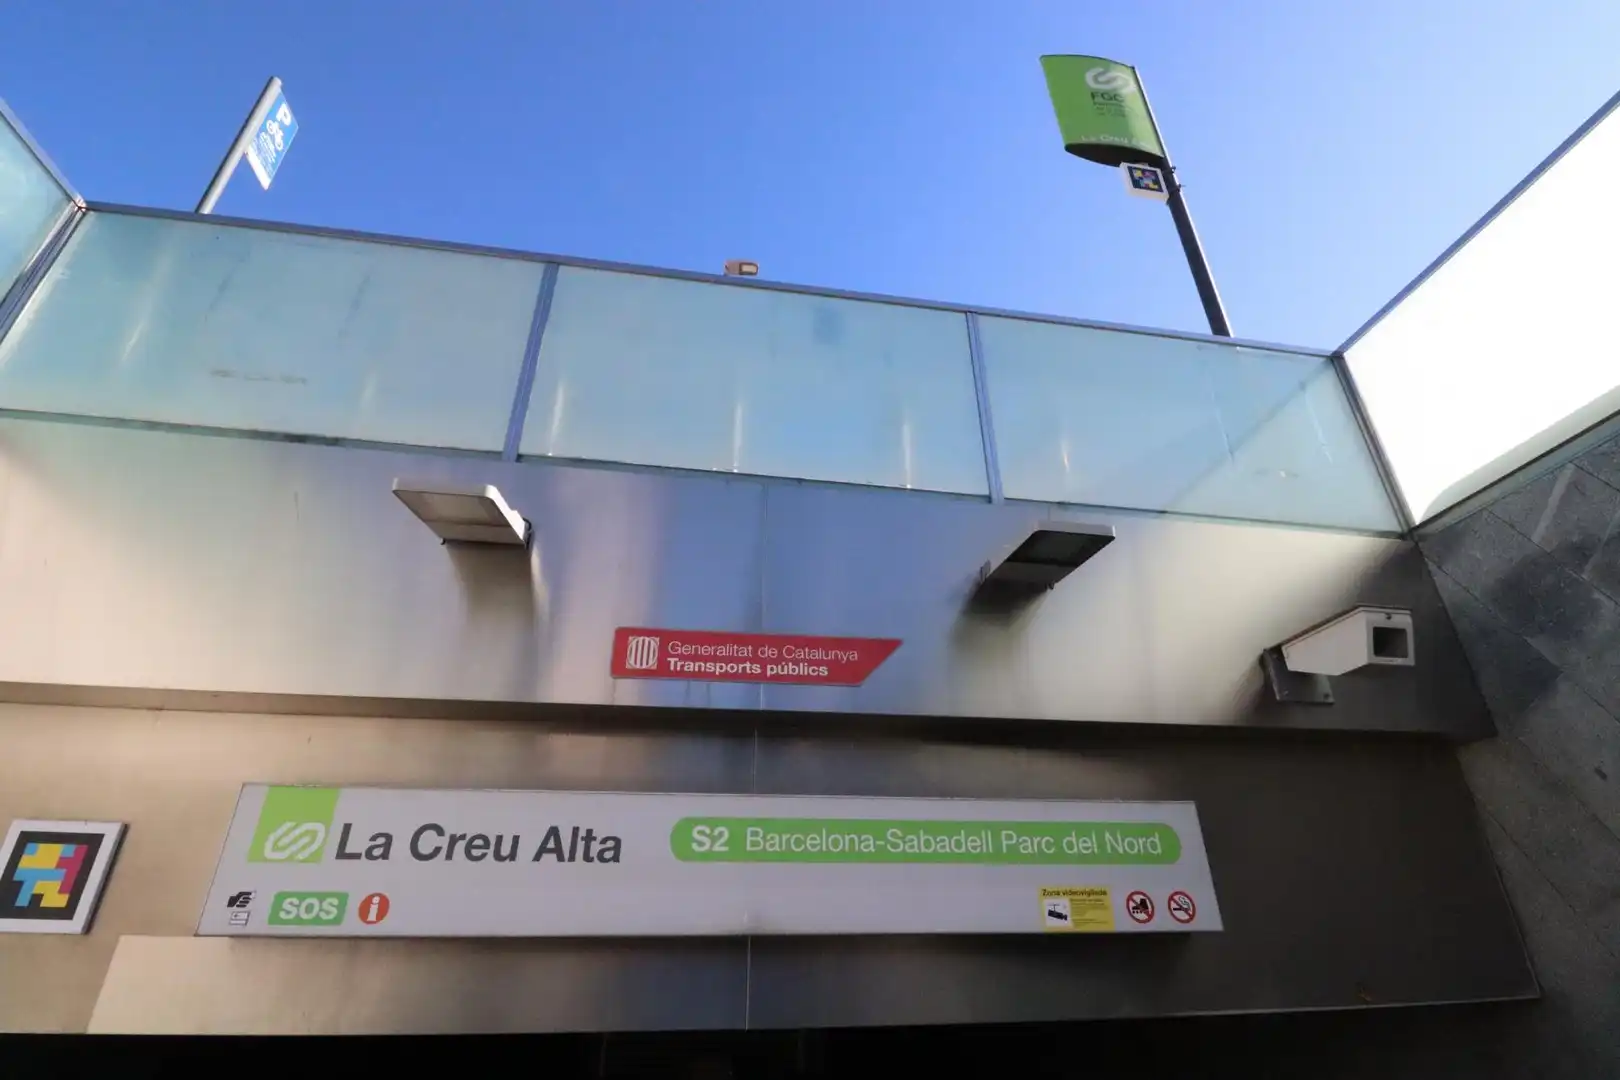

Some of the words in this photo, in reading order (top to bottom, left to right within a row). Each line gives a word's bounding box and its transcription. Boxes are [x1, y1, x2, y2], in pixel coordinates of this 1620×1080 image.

[1090, 91, 1125, 102] FGC
[668, 640, 753, 658] Generalitat
[758, 643, 777, 659] de
[782, 645, 858, 664] Catalunya
[667, 657, 761, 675] Transports
[767, 660, 829, 678] públics
[335, 822, 393, 861] La
[409, 823, 521, 863] Creu
[531, 825, 622, 864] Alta
[690, 825, 730, 852] S2
[746, 827, 993, 855] Barcelona-Sabadell
[1003, 831, 1055, 856] Parc
[1062, 831, 1097, 856] del
[1106, 832, 1162, 857] Nord
[1042, 888, 1061, 897] Zona
[279, 897, 339, 921] SOS
